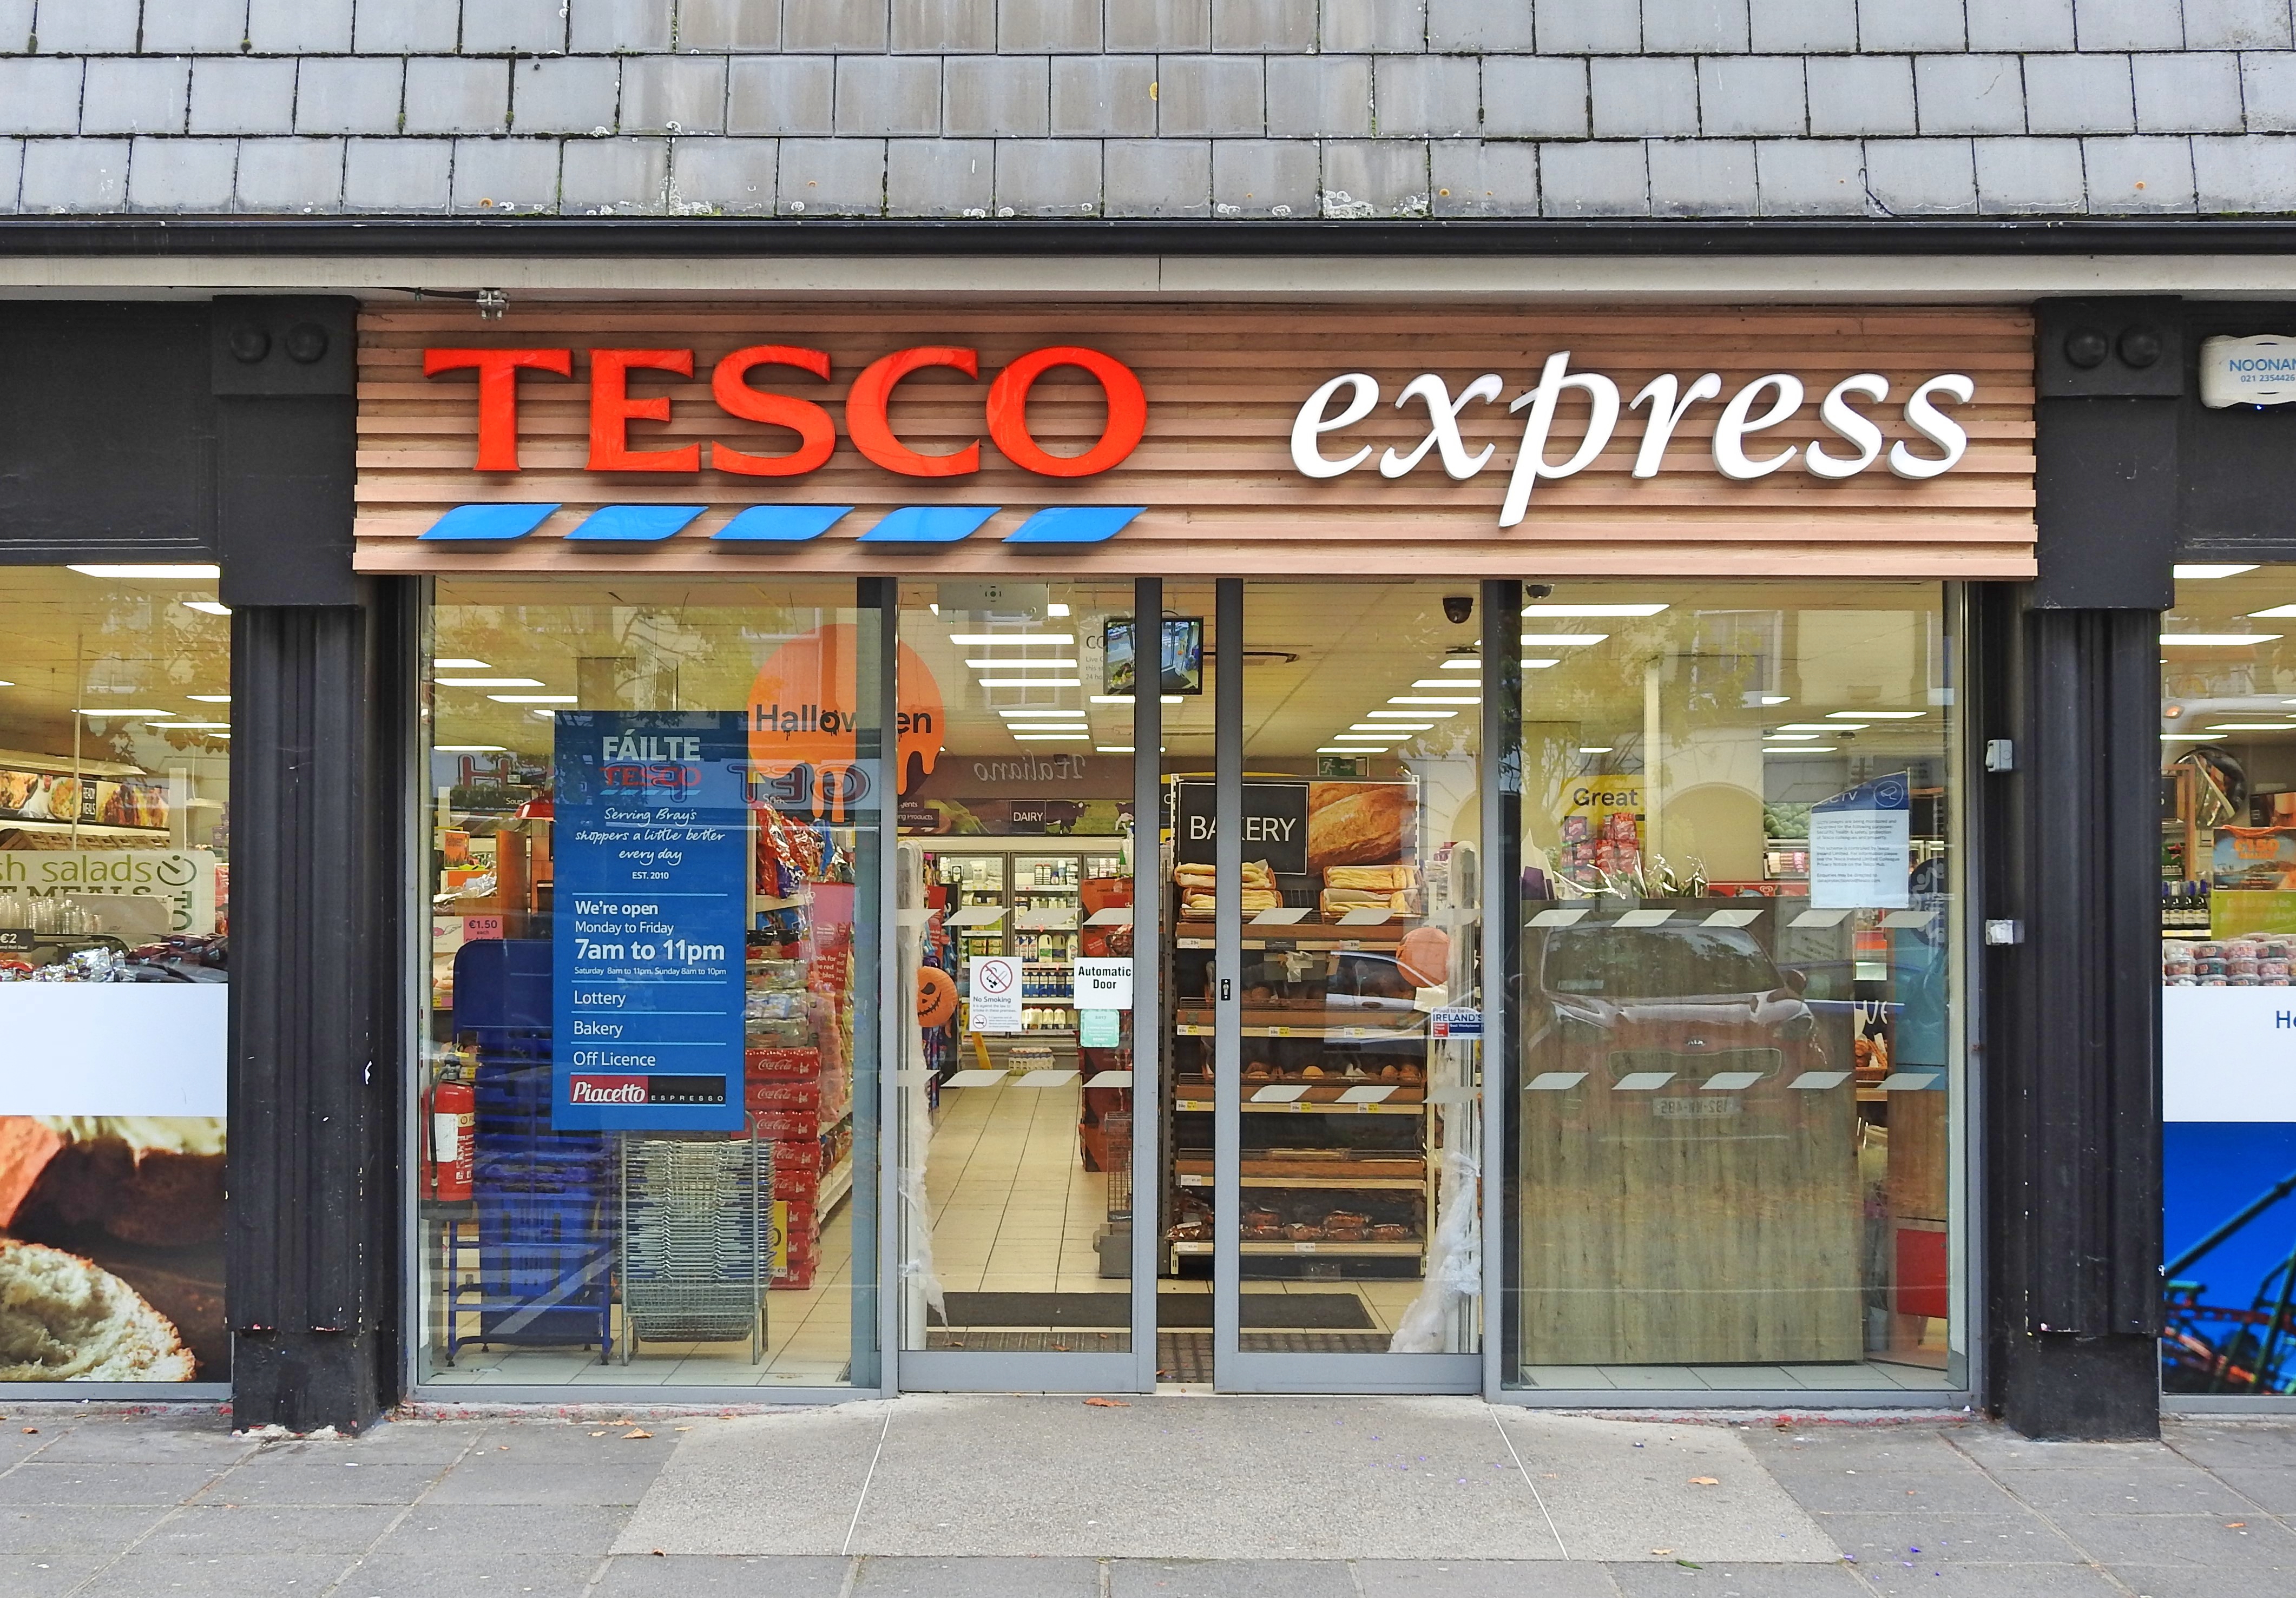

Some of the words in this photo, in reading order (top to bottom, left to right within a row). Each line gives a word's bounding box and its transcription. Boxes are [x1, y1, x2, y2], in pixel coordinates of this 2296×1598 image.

[424, 345, 1147, 477] TESCO
[1290, 350, 1975, 528] express
[1086, 635, 1103, 649] CC
[602, 729, 701, 761] FÁILTE
[600, 767, 702, 787] TESCO
[1573, 788, 1637, 806] Great
[604, 807, 651, 828] Serving
[656, 808, 697, 827] Bray's
[1013, 812, 1043, 822] DAIRY
[575, 830, 629, 844] shoppers
[633, 833, 641, 841] a
[644, 829, 682, 841] little
[686, 828, 726, 841] better
[1190, 816, 1297, 842] BERY
[619, 850, 654, 866] every
[657, 848, 682, 866] day
[42, 854, 152, 883] salads
[575, 900, 618, 915] We're
[622, 904, 659, 917] open
[469, 920, 498, 929] €1.50
[575, 921, 622, 935] Monday
[624, 923, 636, 933] to
[640, 921, 674, 936] Friday
[0, 933, 17, 943] €2
[575, 939, 624, 959] 7am
[630, 941, 656, 960] to
[663, 939, 725, 965] 11pm
[574, 967, 604, 975] Saturday
[655, 967, 680, 976] Sunday
[707, 968, 726, 976] 10pm
[1078, 966, 1131, 976] Automatic
[1093, 979, 1116, 989] Door
[574, 990, 626, 1008] Lottery
[1433, 1014, 1482, 1022] IRELAND'S
[574, 1021, 623, 1038] Bakery
[573, 1051, 598, 1066] Off
[601, 1052, 656, 1066] Licence
[573, 1081, 646, 1102] Piacetto
